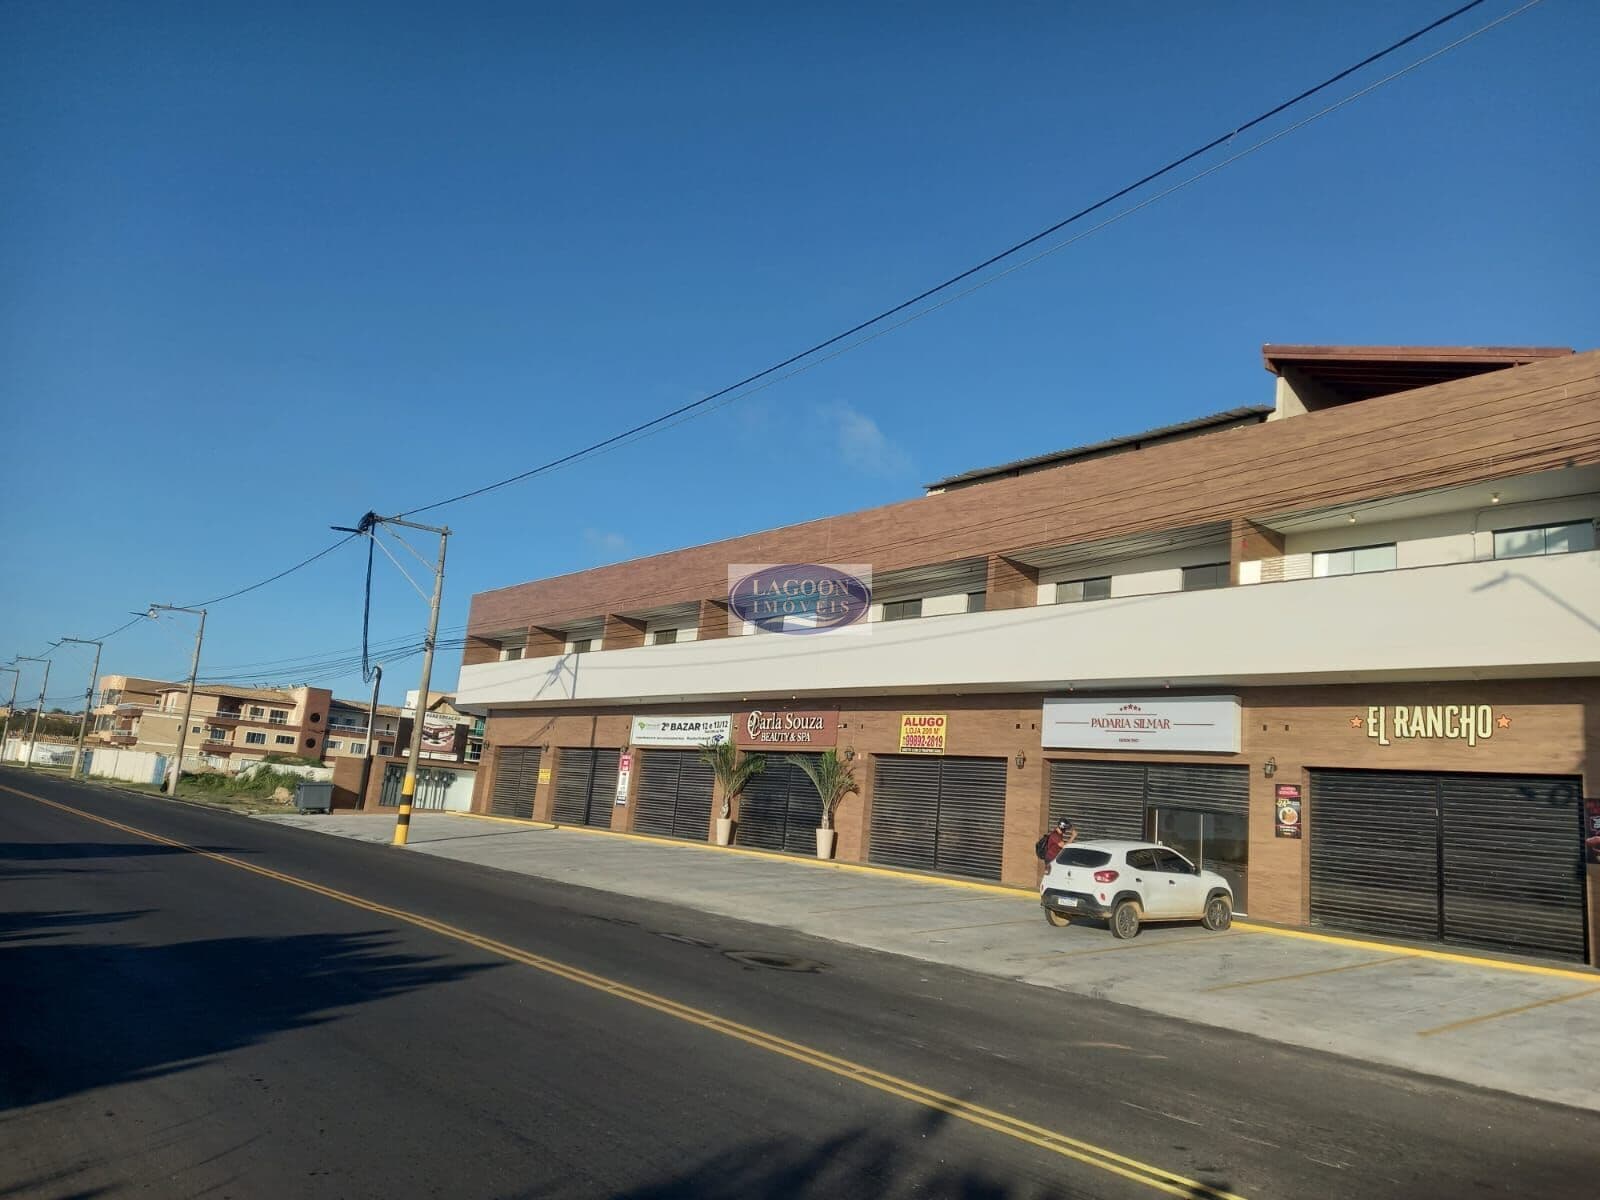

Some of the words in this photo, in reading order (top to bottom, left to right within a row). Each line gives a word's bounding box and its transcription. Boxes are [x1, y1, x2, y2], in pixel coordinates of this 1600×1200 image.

[670, 722, 701, 731] BAZAR
[785, 712, 824, 730] Souza
[904, 717, 944, 727] ALUGO
[1091, 718, 1131, 729] PADARIA
[1133, 719, 1171, 730] SILMAR
[1367, 705, 1390, 746] EL
[1394, 704, 1493, 747] RANCHO
[761, 732, 789, 742] BEAUTY
[797, 732, 811, 742] SPA
